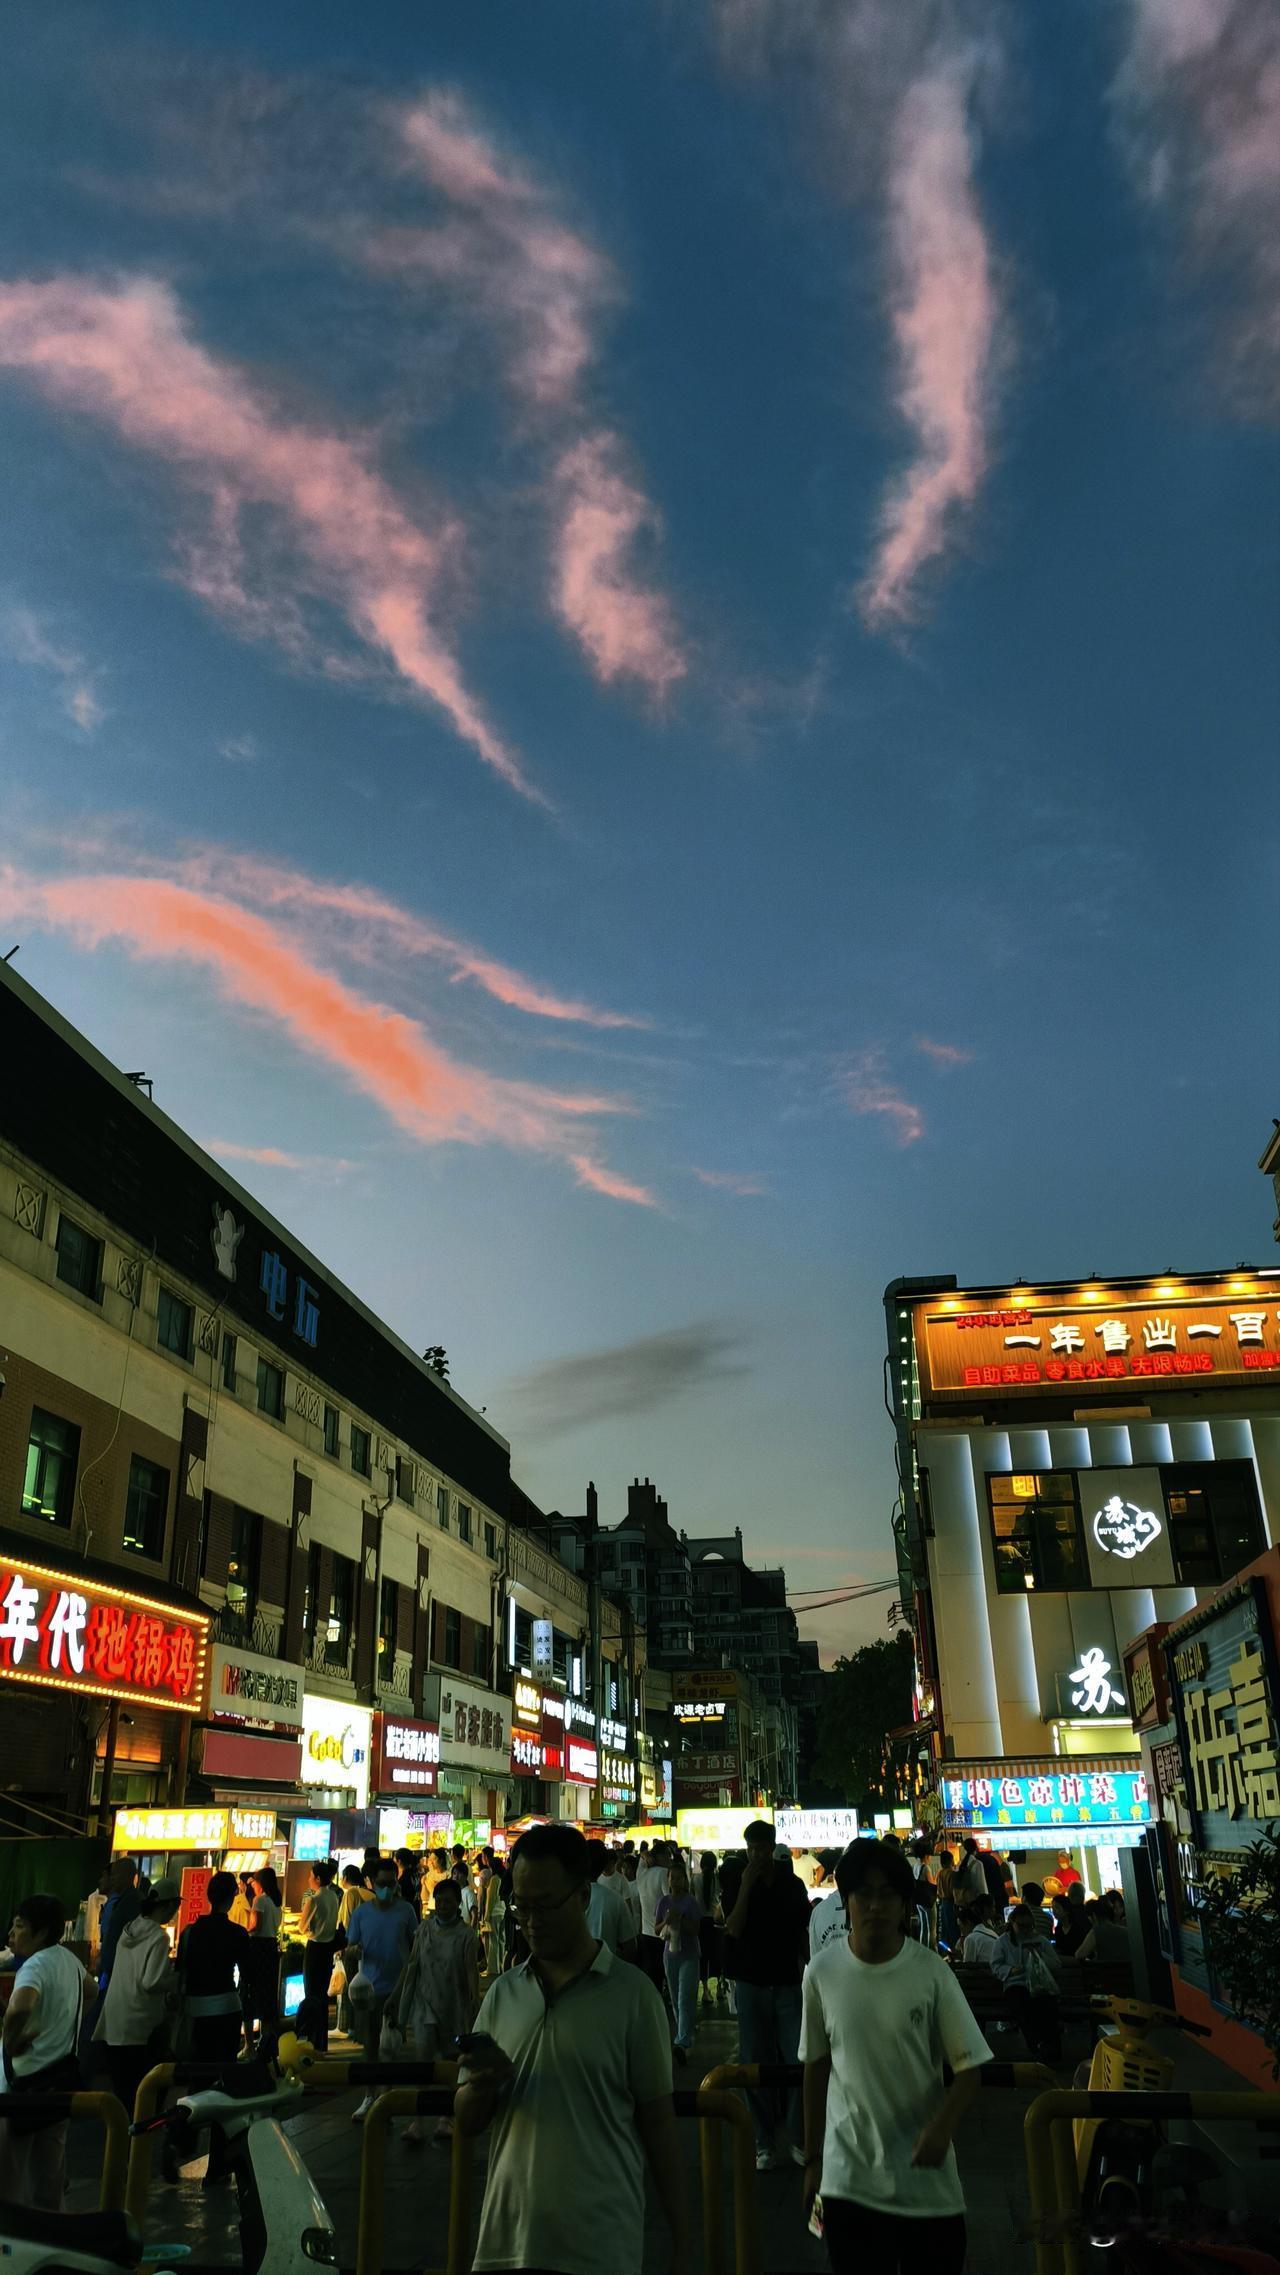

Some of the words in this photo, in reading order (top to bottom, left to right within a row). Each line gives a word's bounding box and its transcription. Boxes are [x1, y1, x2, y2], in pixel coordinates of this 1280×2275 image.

[259, 1249, 320, 1348] 电玩
[1005, 1312, 1280, 1353] 一年售出一百
[964, 1363, 1041, 1385] 自助菜品
[1046, 1356, 1125, 1379] 零食水果
[1132, 1351, 1213, 1375] 无限畅吃
[1243, 1350, 1280, 1368] 加盟
[1069, 1648, 1125, 1713] 苏
[454, 1700, 504, 1751] 百家超市
[308, 1730, 342, 1762] CoCo
[676, 1754, 737, 1770] 布丁酒店
[968, 1776, 1116, 1807] 特色凉拌菜
